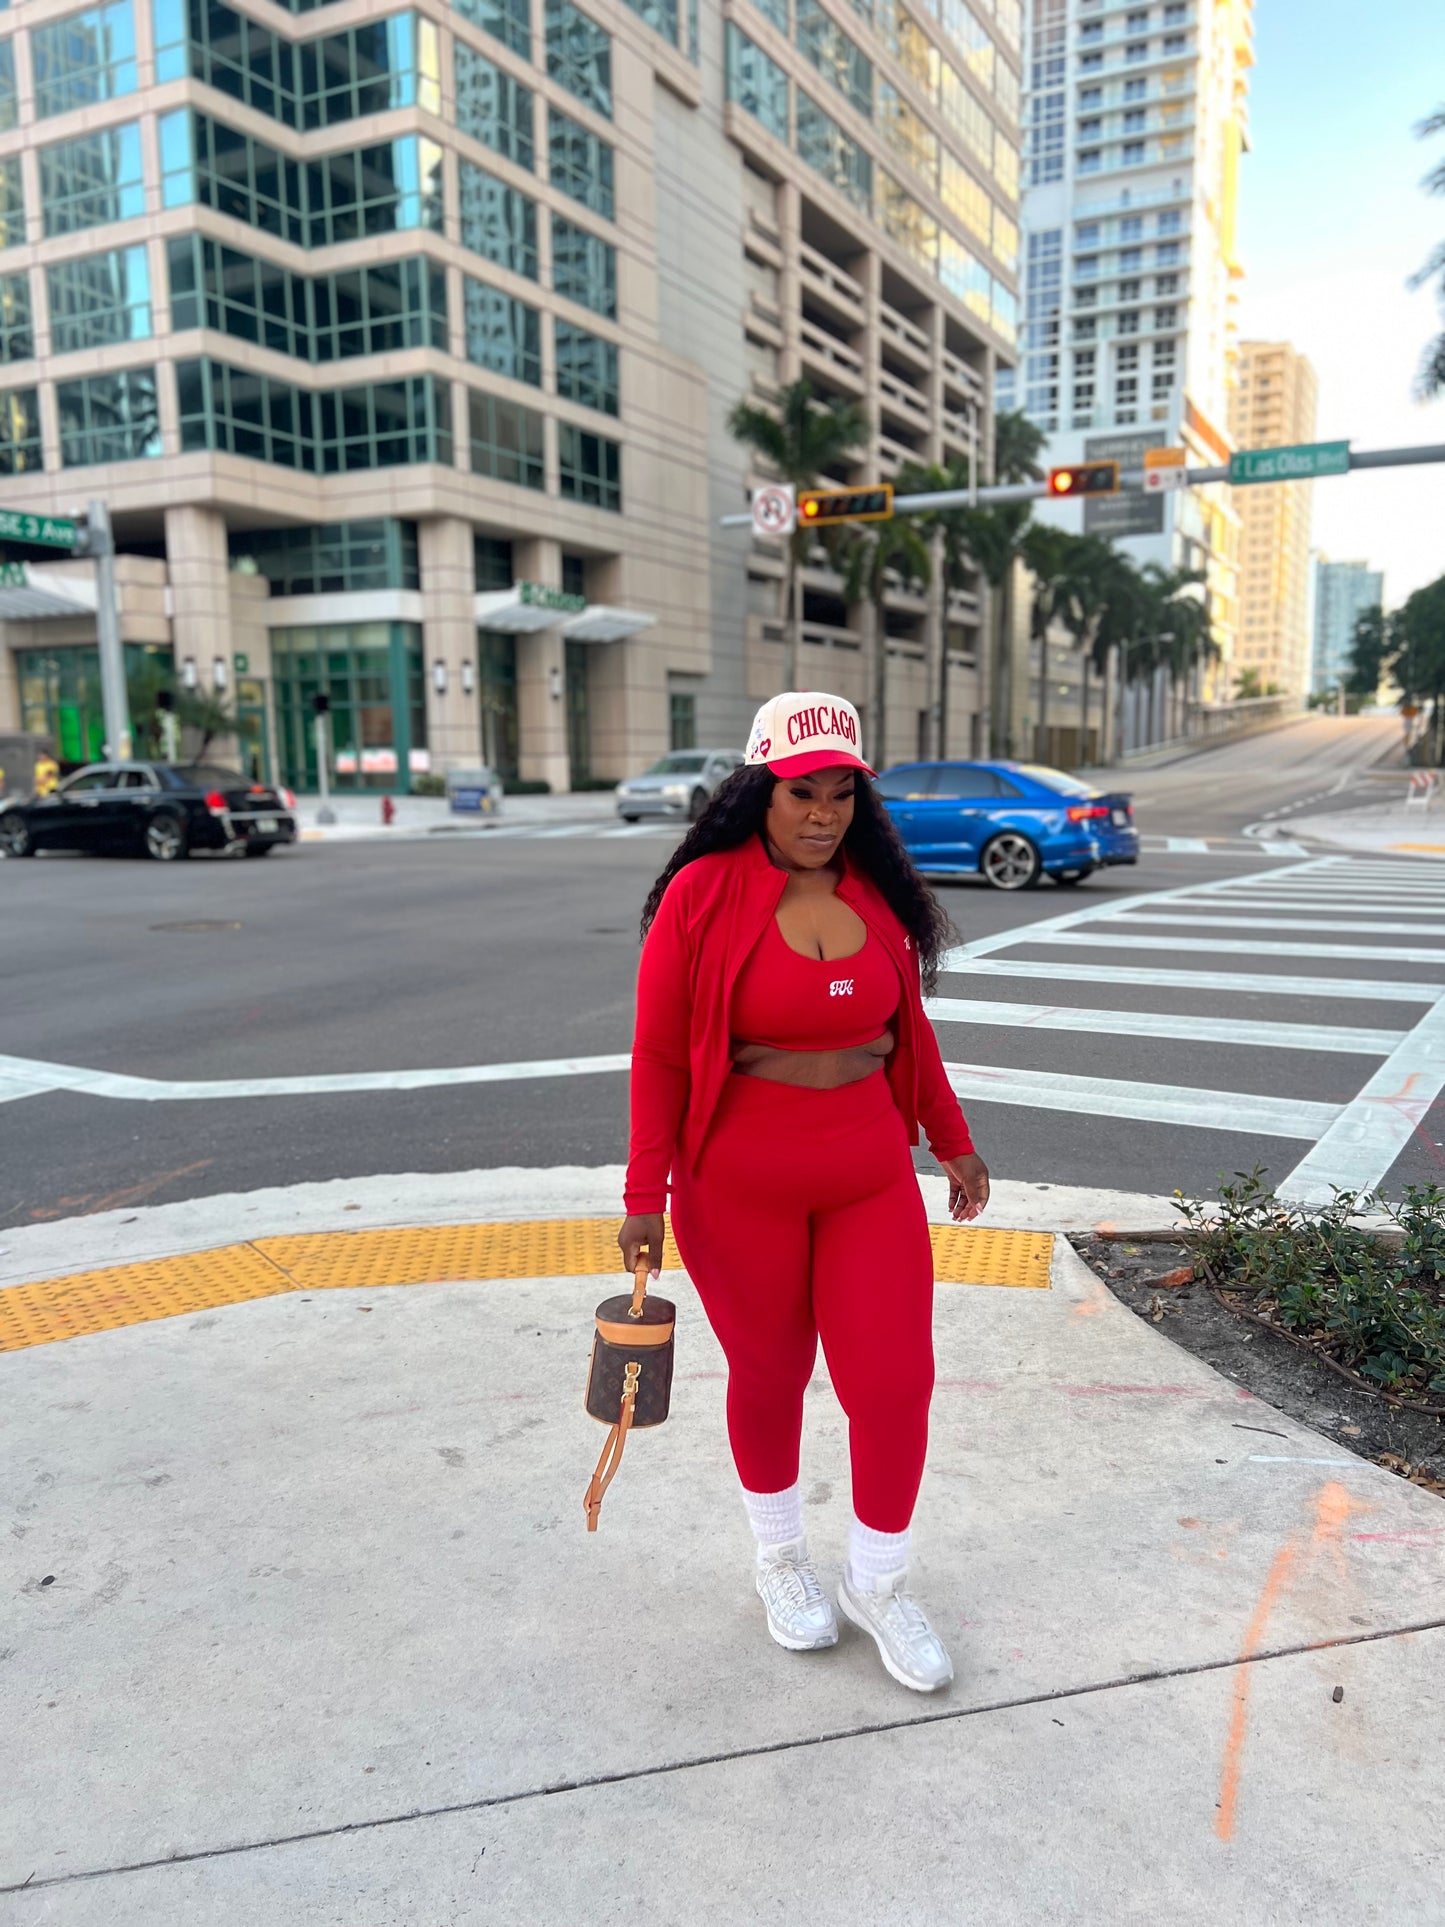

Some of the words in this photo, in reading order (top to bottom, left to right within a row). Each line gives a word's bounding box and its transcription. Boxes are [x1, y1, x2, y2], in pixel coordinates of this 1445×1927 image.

[1244, 455, 1275, 478] Las
[1277, 452, 1313, 475] Olas
[25, 516, 40, 538] 3
[42, 520, 76, 544] Ave
[787, 706, 857, 746] CHICAGO
